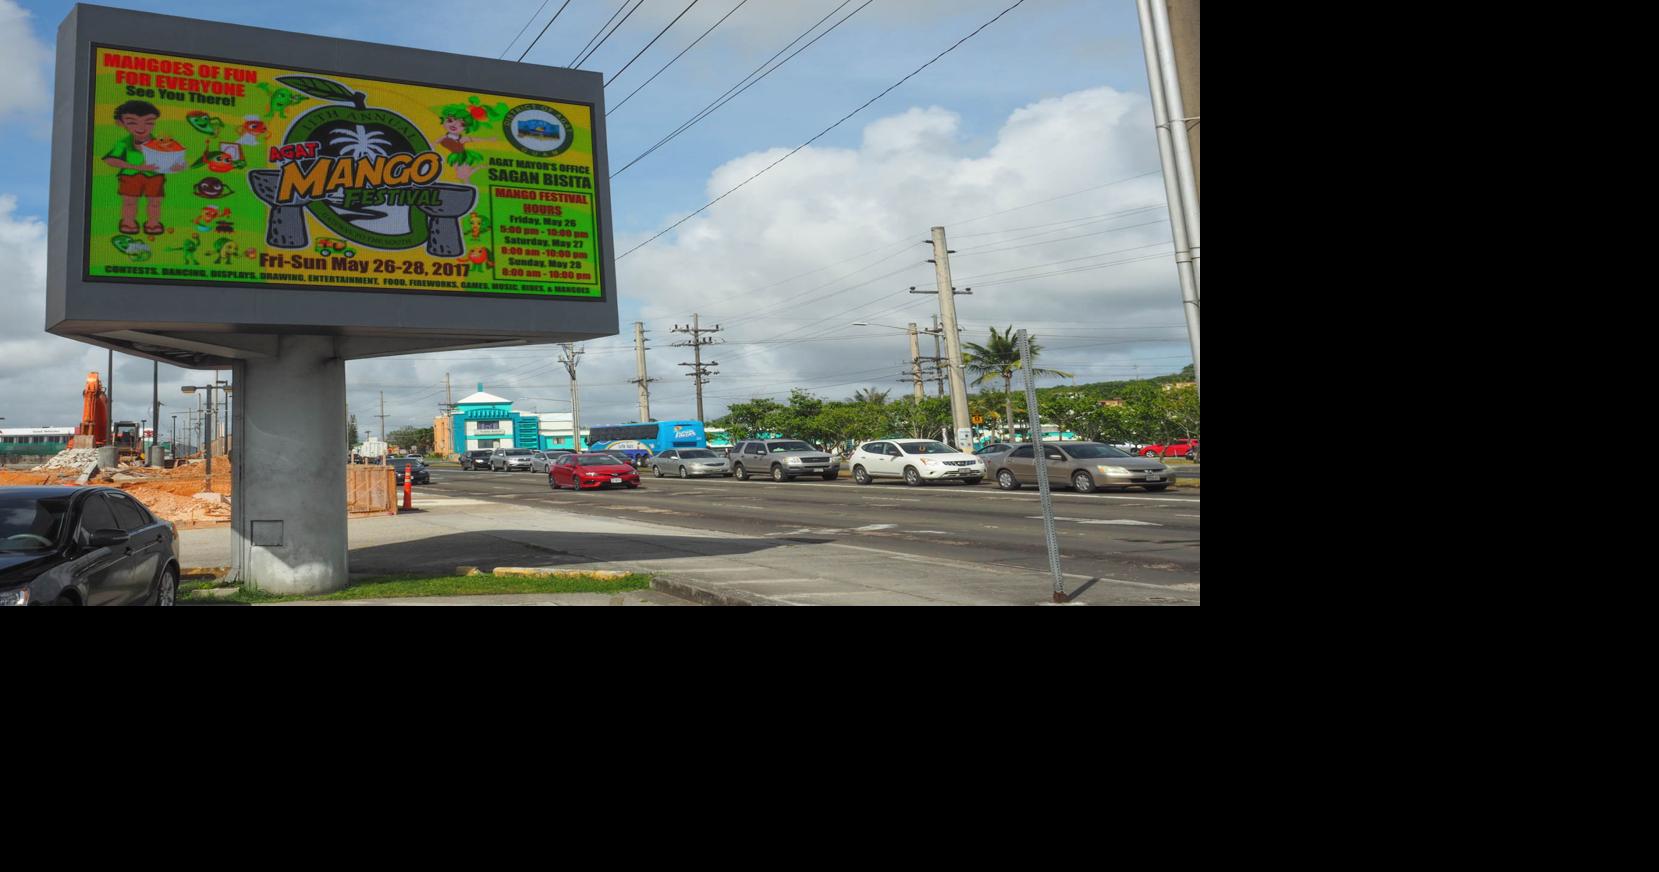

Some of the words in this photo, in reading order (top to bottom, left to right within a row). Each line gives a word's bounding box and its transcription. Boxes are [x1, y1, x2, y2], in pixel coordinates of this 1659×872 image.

[104, 52, 194, 76] MANGOES
[198, 64, 220, 78] OF
[224, 67, 257, 84] FUN
[116, 70, 154, 87] FOR
[156, 74, 245, 97] EVERYONE
[126, 86, 155, 98] See
[158, 88, 185, 102] You
[190, 92, 236, 106] There!
[269, 142, 318, 162] AGAT
[489, 157, 514, 167] AGAT
[516, 160, 558, 171] MAYOR'S
[560, 164, 590, 174] OFFICE
[277, 152, 442, 203] MANGO
[488, 168, 540, 185] SAGAN
[543, 173, 592, 189] BISITA
[344, 188, 442, 208] FESTIVAL
[496, 188, 536, 200] MANGO
[540, 191, 588, 205] FESTIVAL
[523, 204, 562, 216] HOURS
[543, 218, 562, 227] May
[564, 219, 576, 228] 26
[547, 228, 572, 238] 10:00
[552, 239, 571, 249] May
[572, 240, 584, 248] 27
[260, 252, 327, 270] Fri-Sun
[331, 256, 369, 274] May
[373, 259, 428, 276] 26-28,
[432, 262, 470, 276] 2017
[572, 252, 588, 260] pm
[548, 260, 568, 270] May
[570, 260, 582, 269] 28
[549, 270, 574, 280] 10:00
